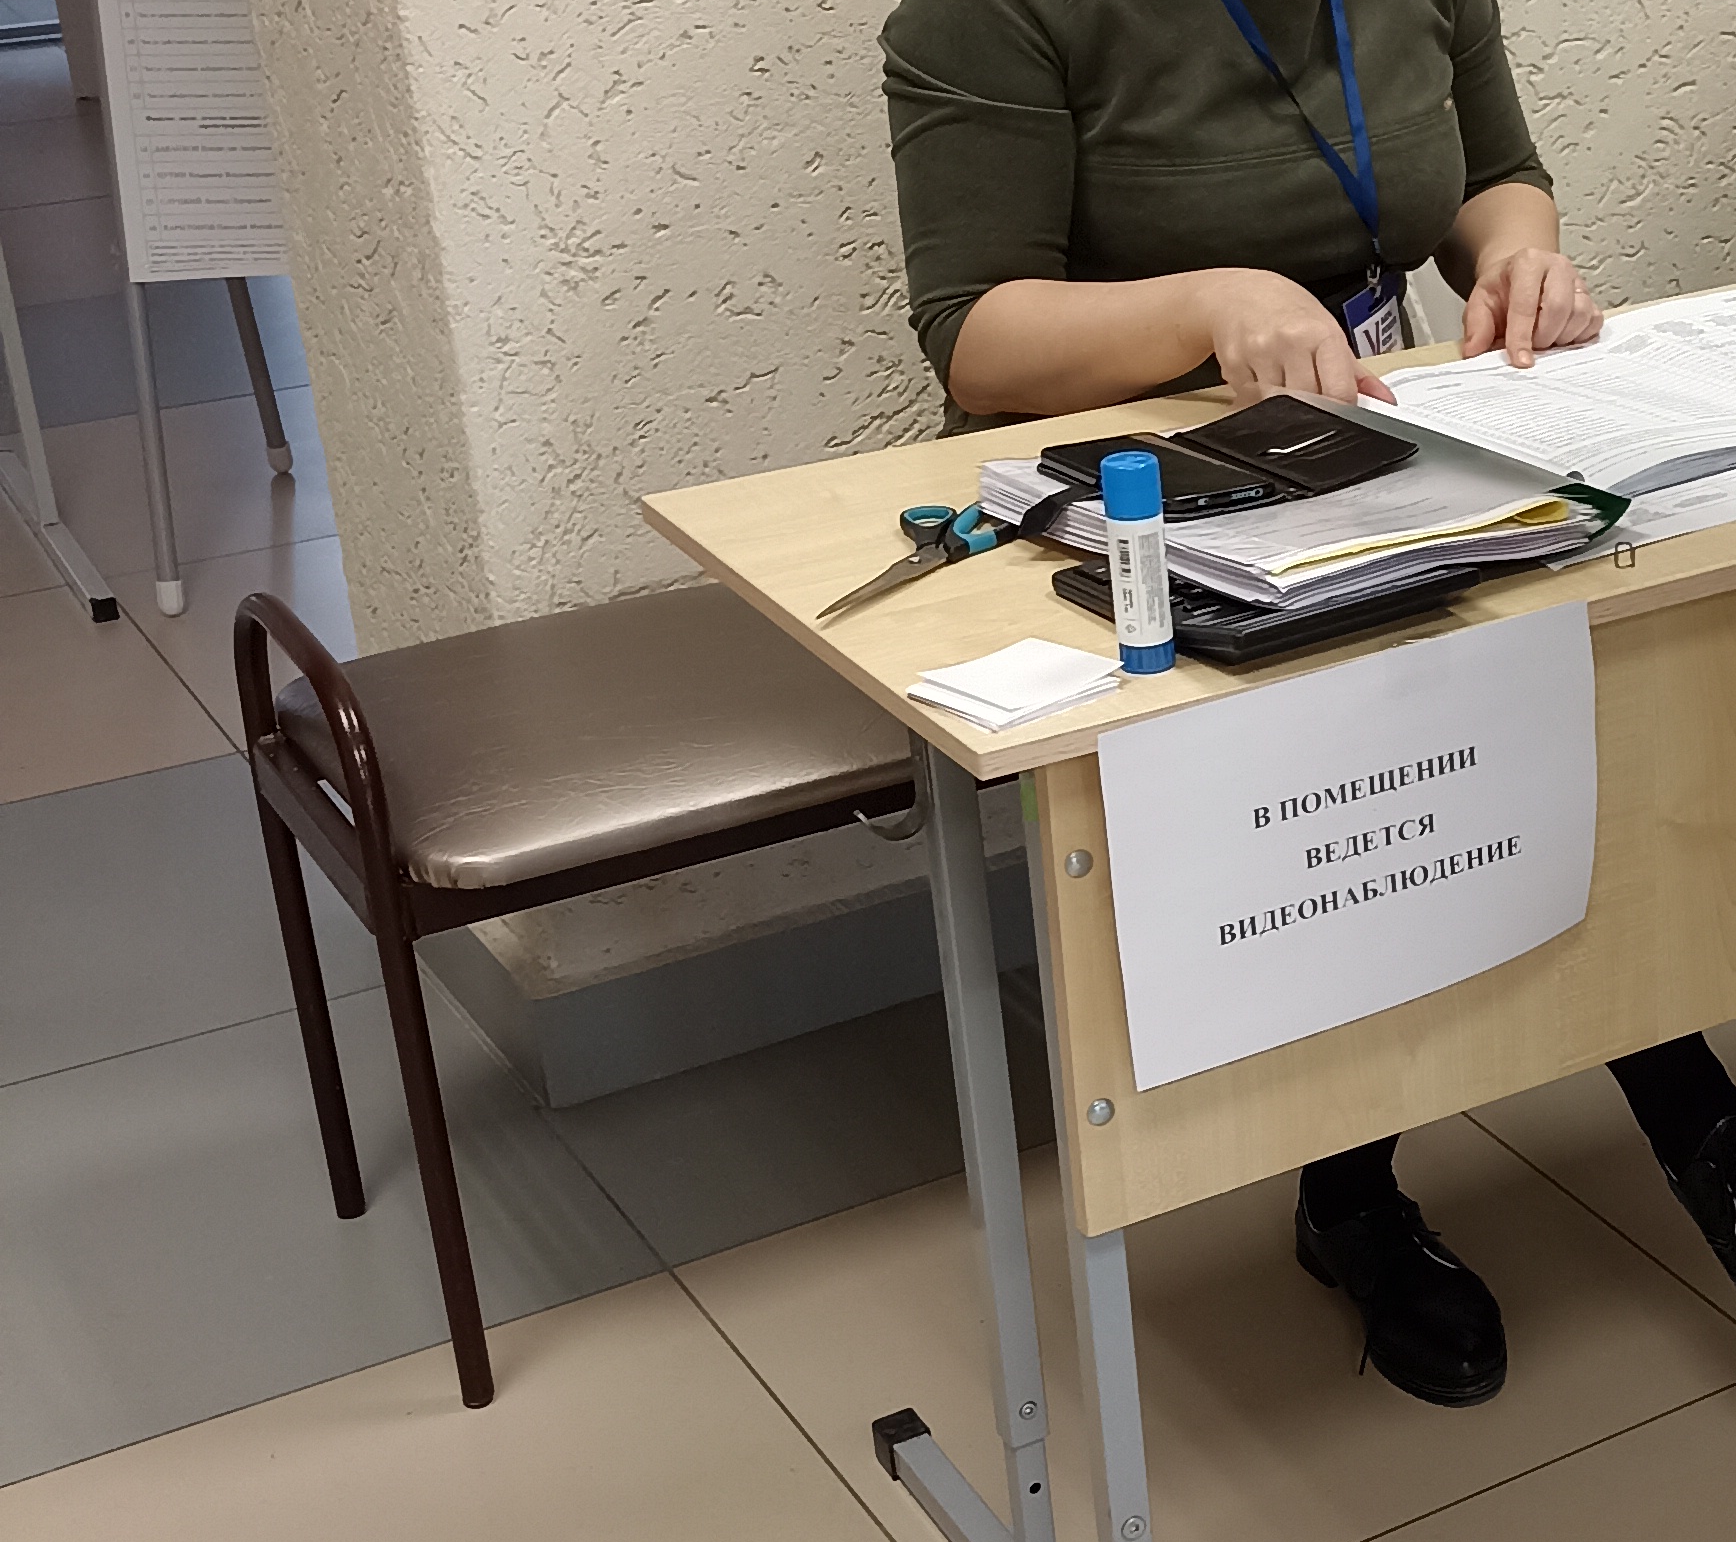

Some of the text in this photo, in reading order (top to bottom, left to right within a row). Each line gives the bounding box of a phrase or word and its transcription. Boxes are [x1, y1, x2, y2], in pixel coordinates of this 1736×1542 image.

[1253, 746, 1479, 830] В ПОМЕЩЕНИИ
[1305, 813, 1436, 870] ВЕДЕТСЯ
[1218, 835, 1523, 947] ВИДЕОНАБЛЮДЕНИЕ
